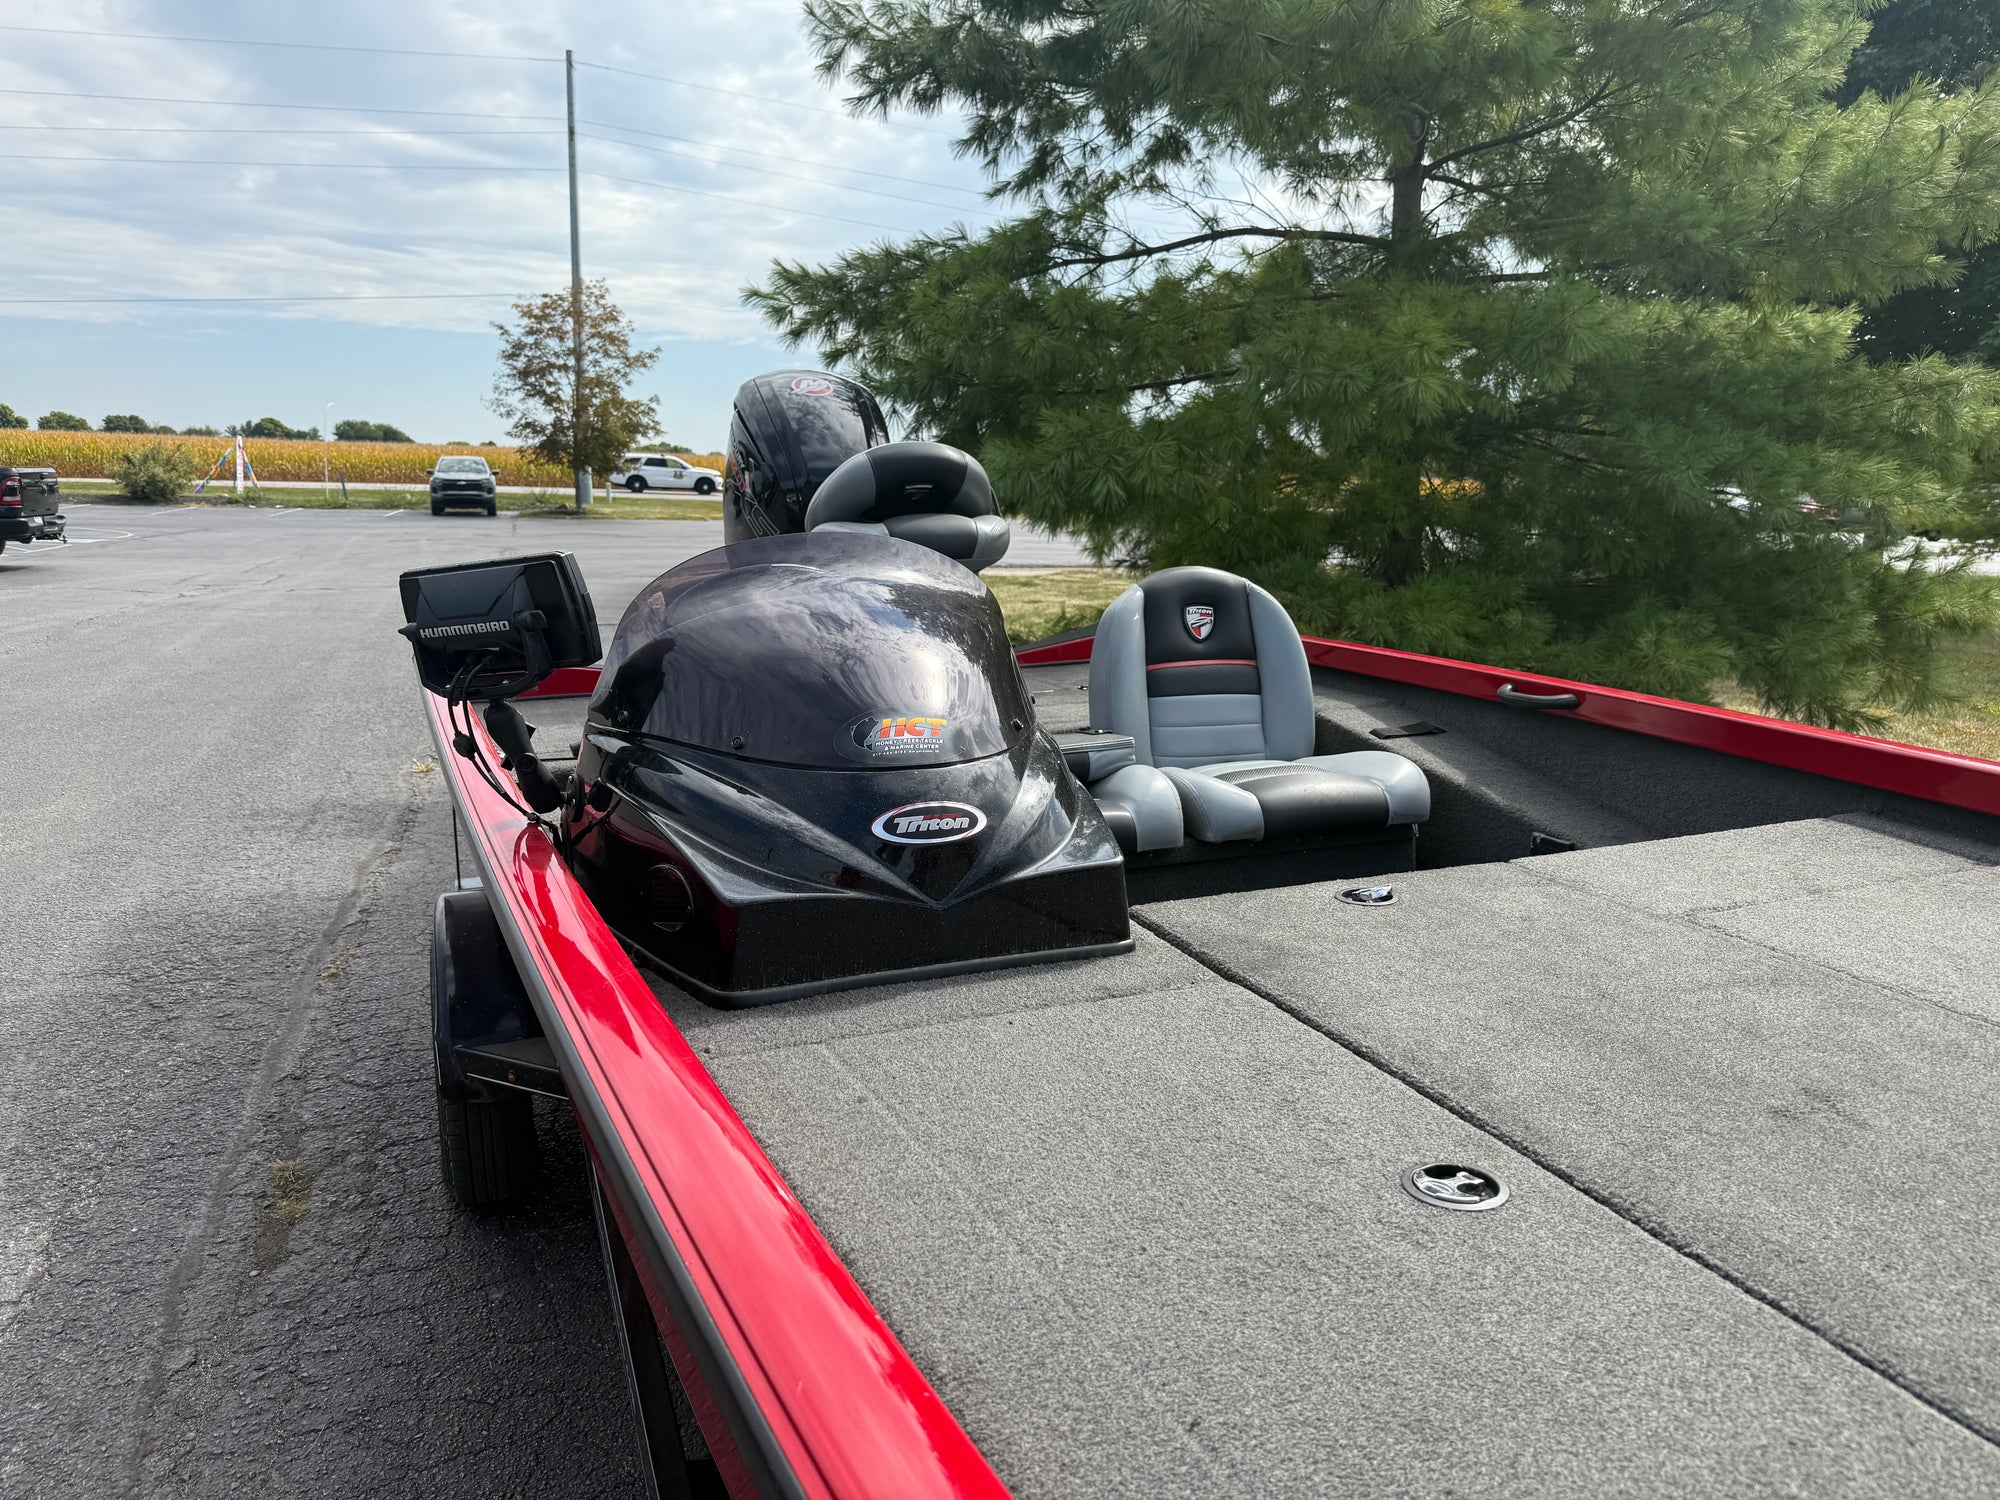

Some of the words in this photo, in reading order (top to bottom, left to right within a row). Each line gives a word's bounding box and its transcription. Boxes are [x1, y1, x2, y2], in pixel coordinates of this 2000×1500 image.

[420, 621, 510, 638] HUMMINBIRD
[875, 739, 898, 747] HONEY
[893, 815, 970, 834] Triton
